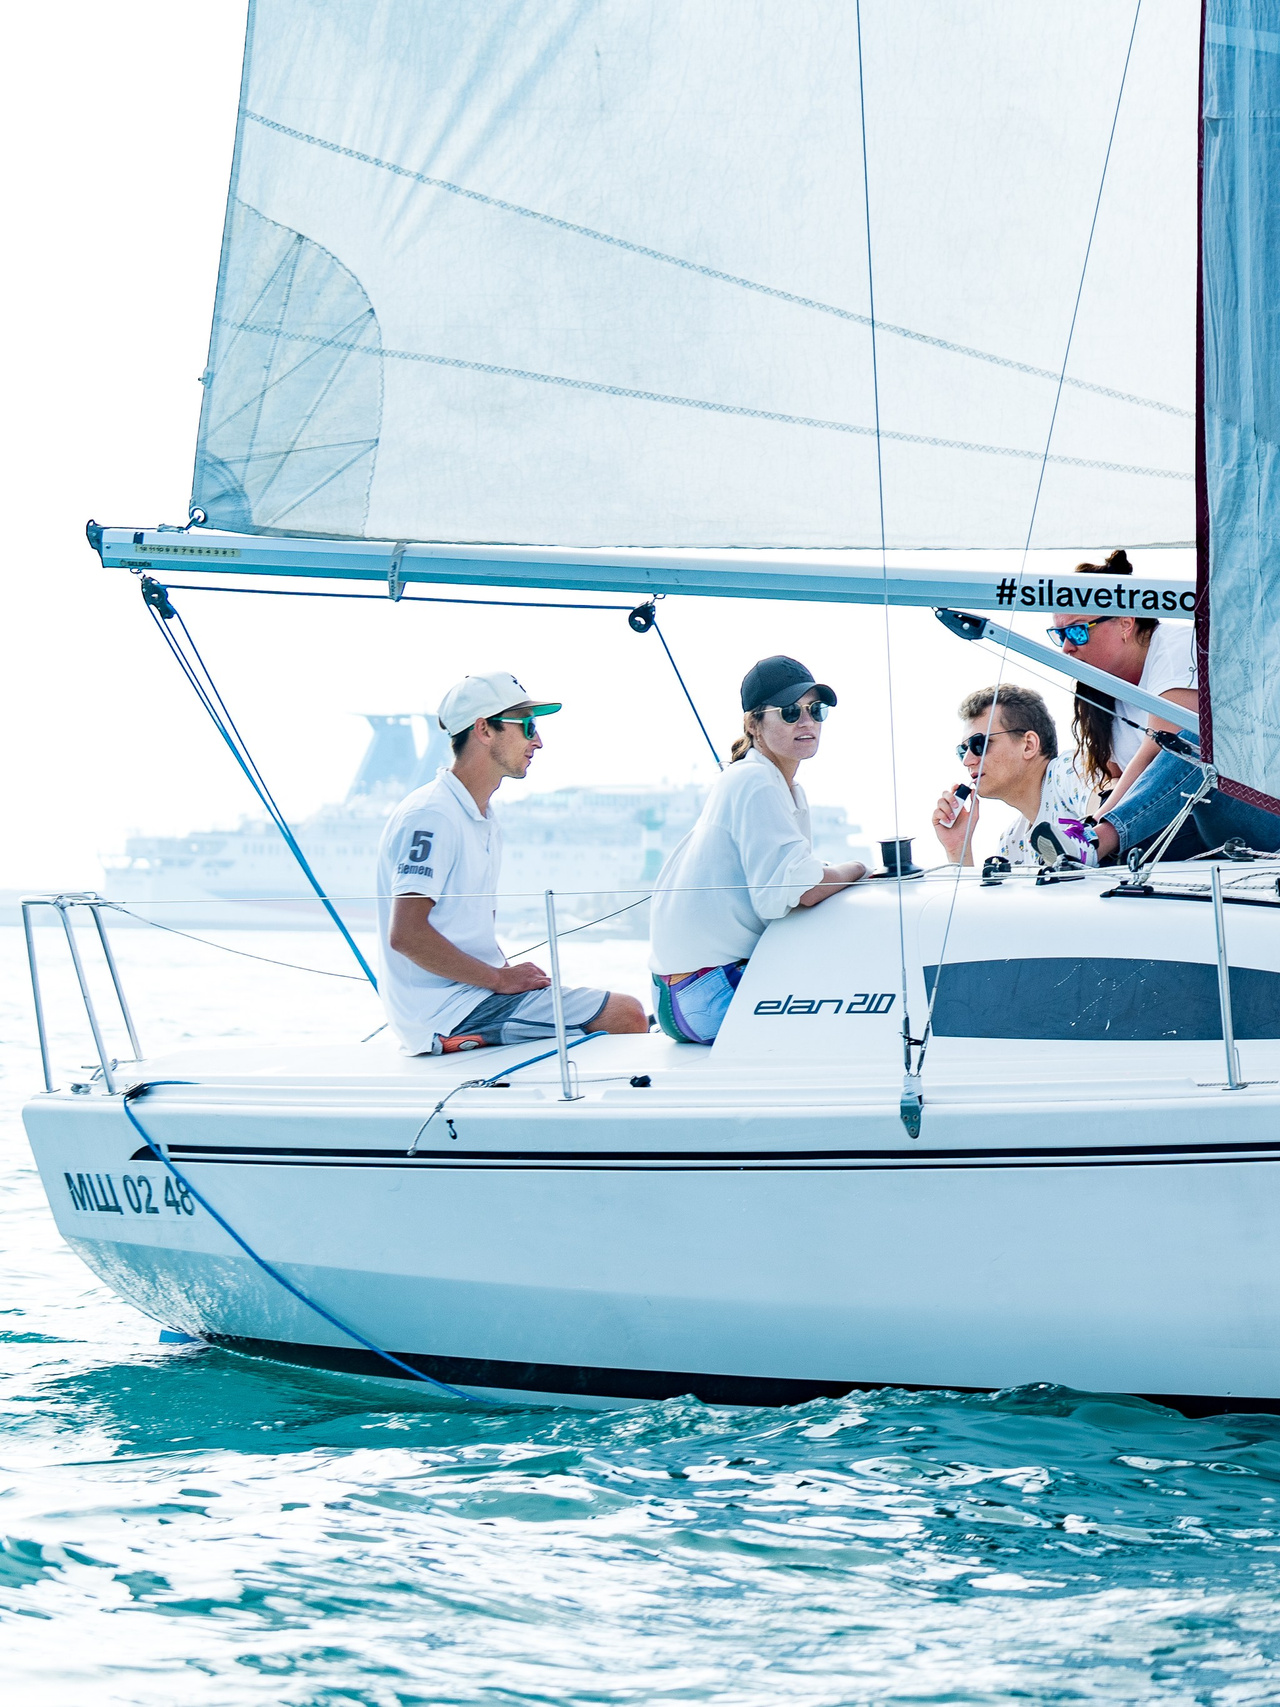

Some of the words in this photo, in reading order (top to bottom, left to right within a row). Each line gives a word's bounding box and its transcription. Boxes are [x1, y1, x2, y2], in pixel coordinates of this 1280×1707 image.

[996, 578, 1196, 612] #silavetraso
[409, 830, 434, 862] 5
[754, 995, 843, 1015] elan
[846, 994, 896, 1014] 210
[123, 1175, 160, 1214] 02
[165, 1176, 196, 1216] 48
